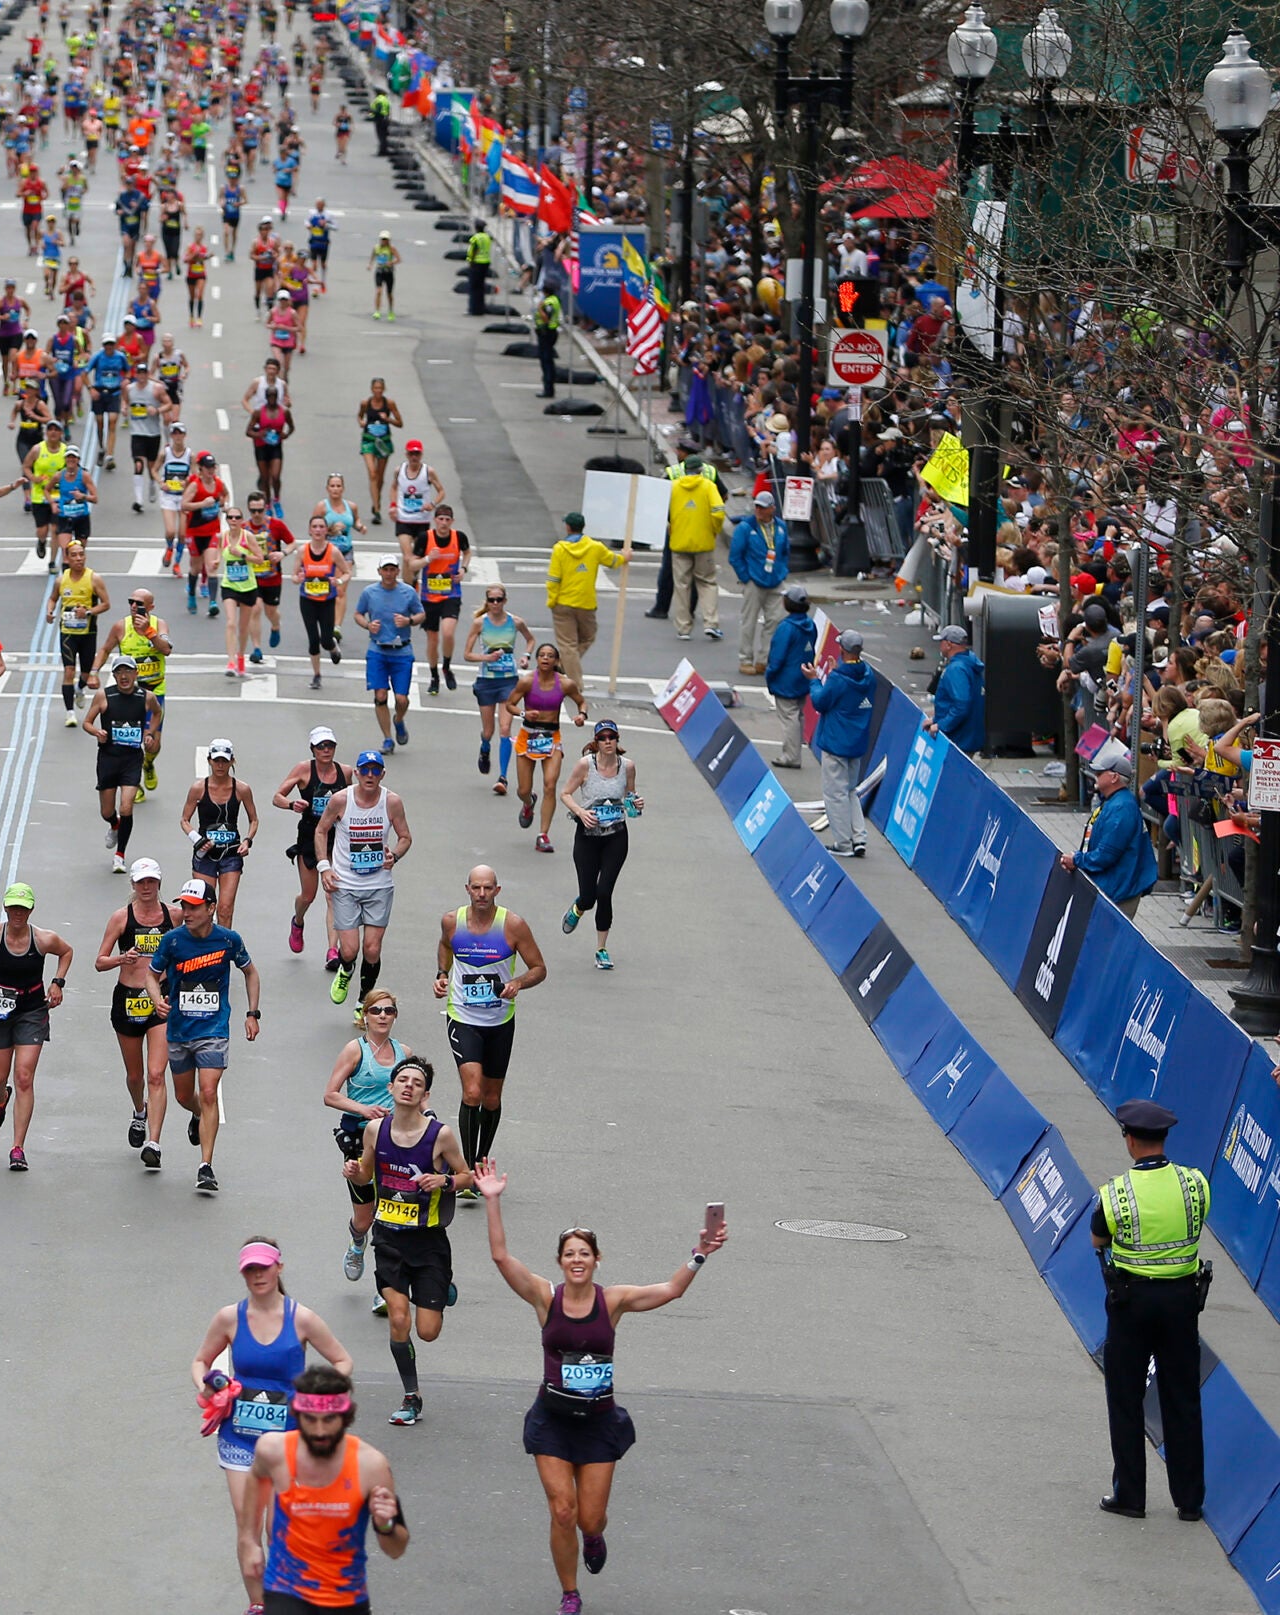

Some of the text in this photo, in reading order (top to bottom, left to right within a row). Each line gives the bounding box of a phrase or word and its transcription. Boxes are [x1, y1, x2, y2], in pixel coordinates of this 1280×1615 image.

[838, 342, 880, 354] DO NOT
[841, 364, 875, 375] ENTER
[113, 729, 141, 738] 16367
[1262, 761, 1275, 770] NO
[369, 817, 384, 825] ROAD
[350, 830, 384, 839] STUMBLERS
[351, 851, 383, 863] 21580
[140, 944, 159, 953] RUNN
[464, 985, 492, 997] 1817
[127, 999, 156, 1010] 2409
[180, 993, 219, 1005] 14650
[379, 1200, 418, 1218] 30146
[1187, 1176, 1200, 1232] POLICE
[1117, 1187, 1132, 1239] BOSTON
[563, 1365, 613, 1381] 20596
[236, 1402, 286, 1422] 17084
